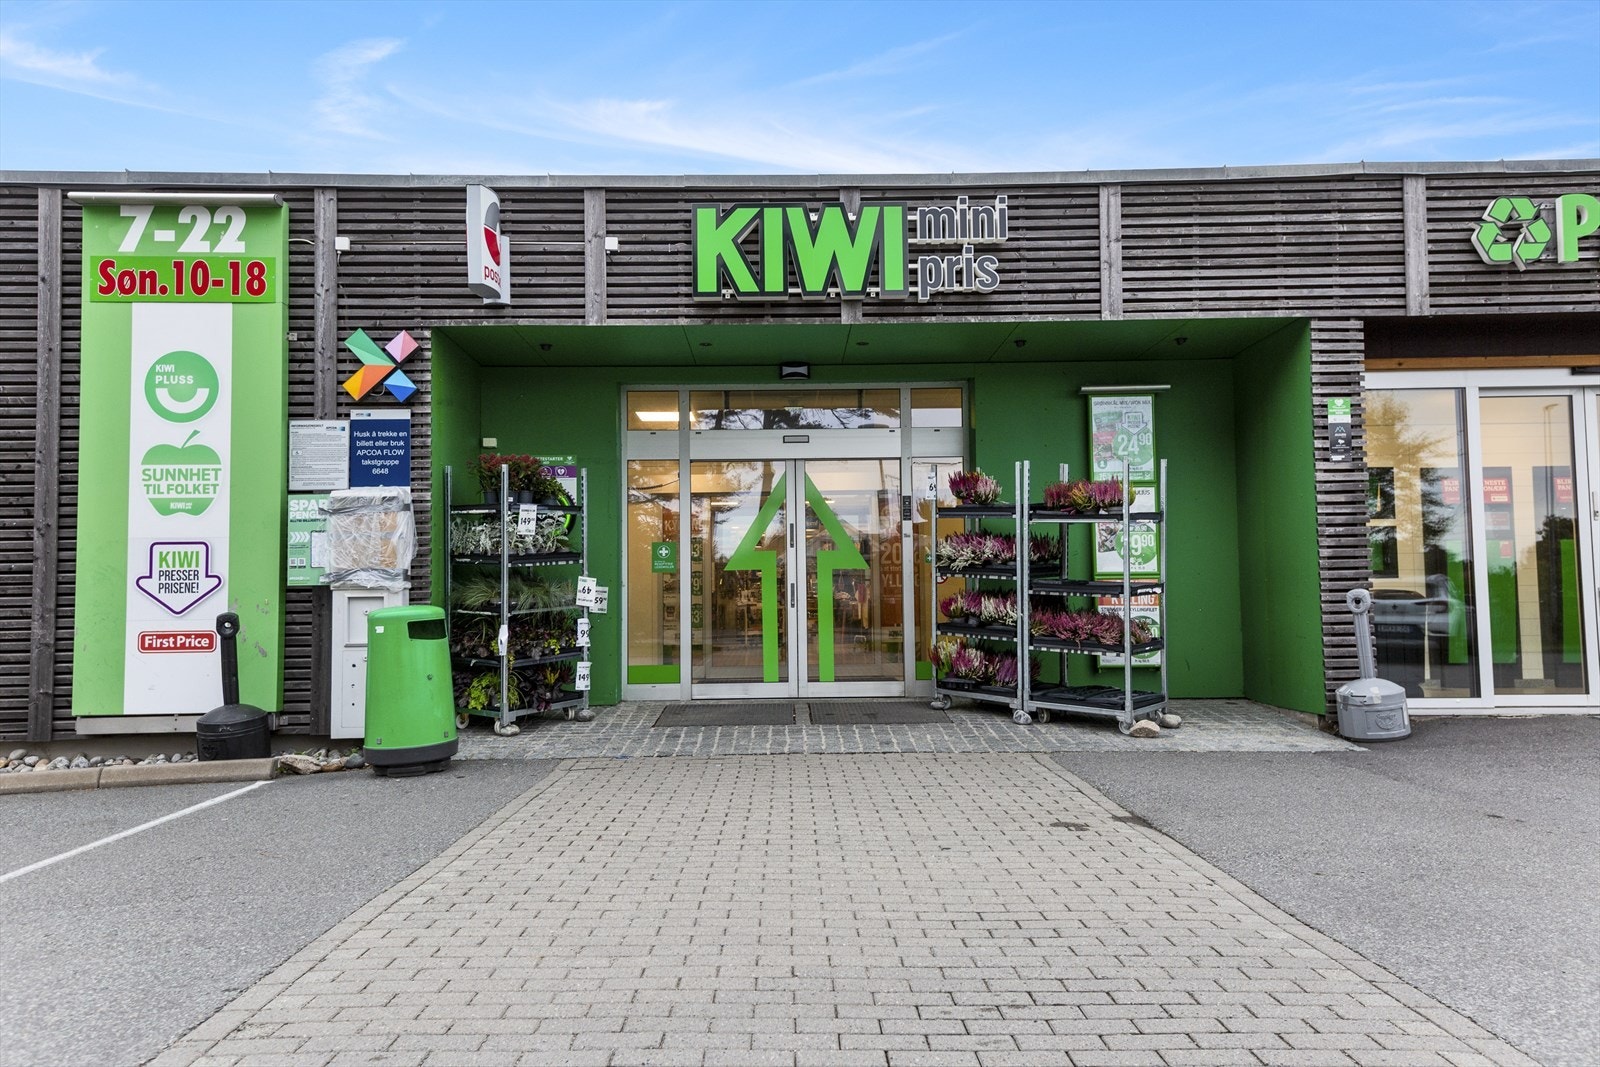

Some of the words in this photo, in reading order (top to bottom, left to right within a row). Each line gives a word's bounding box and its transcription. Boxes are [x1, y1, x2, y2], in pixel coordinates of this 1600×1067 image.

[917, 196, 1008, 243] mini
[117, 205, 247, 253] 7-22
[1555, 193, 1600, 264] P
[692, 202, 908, 300] KIWI
[917, 245, 1000, 302] pris
[155, 364, 175, 373] KIWI
[155, 375, 194, 384] PLUSS
[141, 468, 222, 481] SUNNHET
[144, 484, 164, 494] TIL
[166, 484, 219, 494] FOLKET
[158, 551, 200, 568] KIWI
[158, 570, 199, 581] PRESSER
[158, 582, 199, 594] PRISENE!
[145, 636, 174, 647] First
[177, 635, 210, 647] Price
